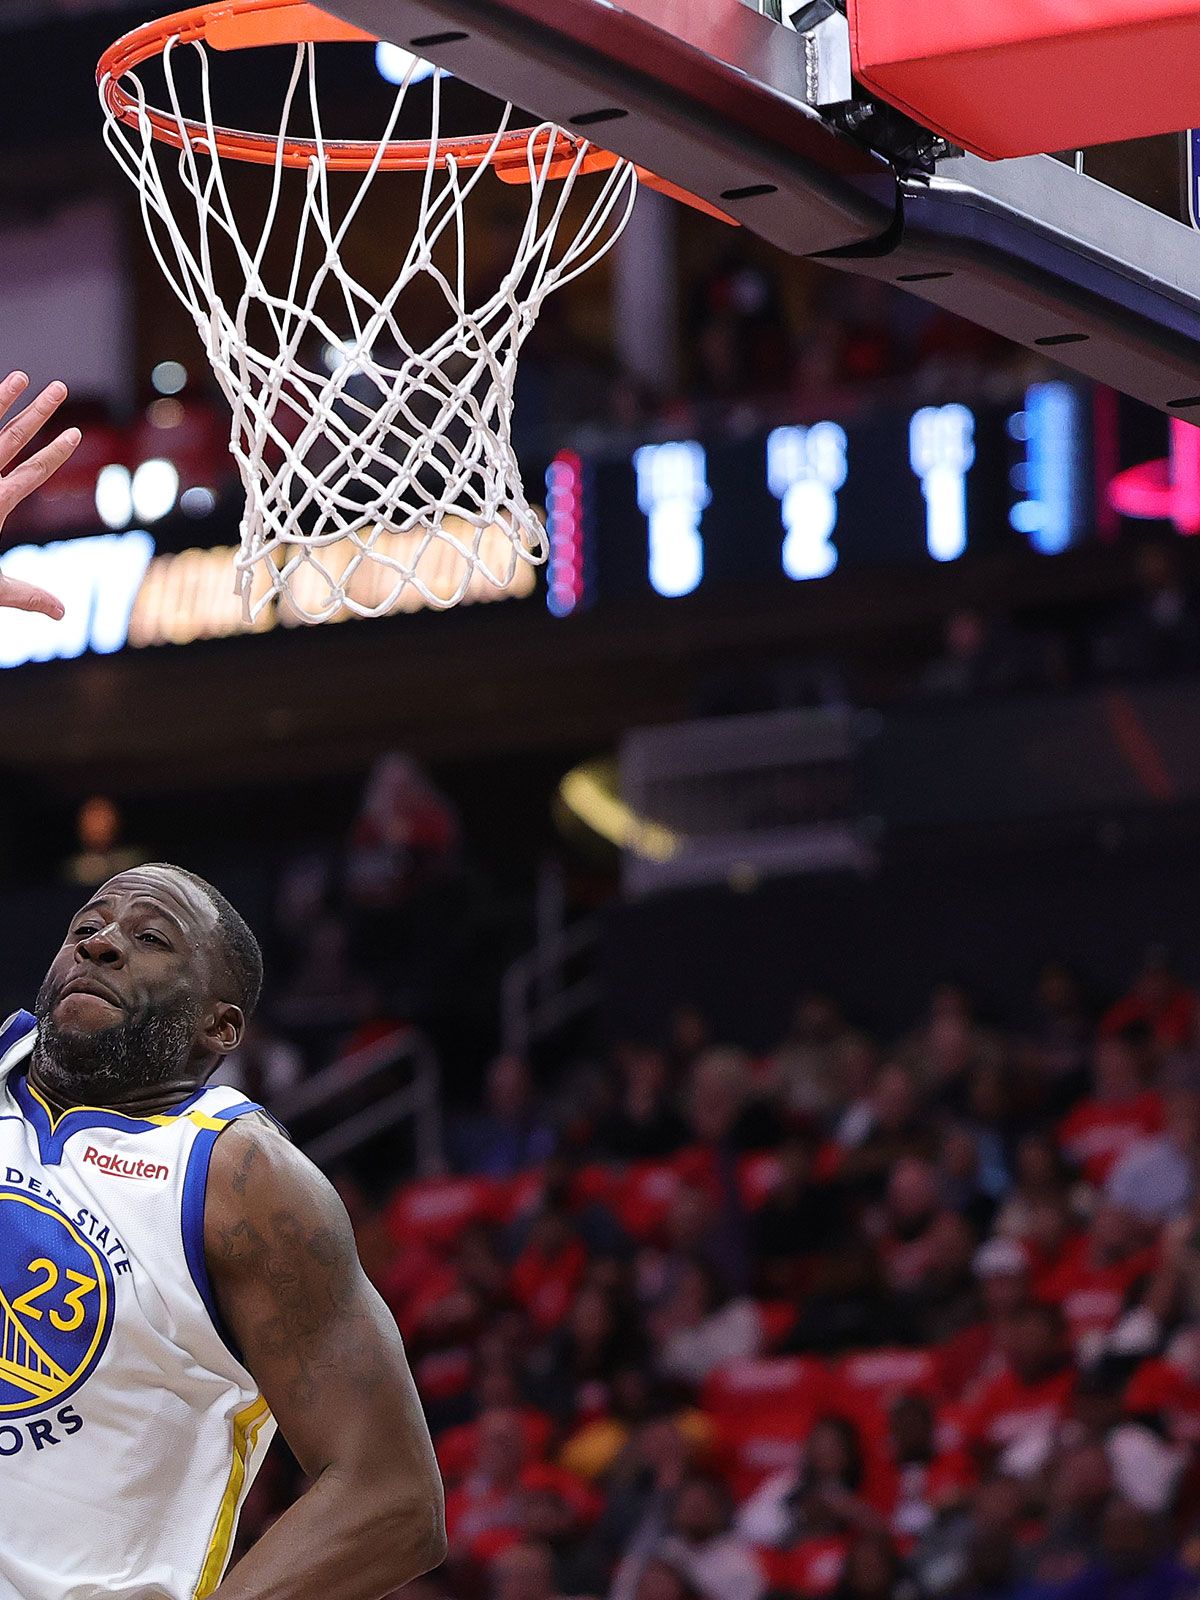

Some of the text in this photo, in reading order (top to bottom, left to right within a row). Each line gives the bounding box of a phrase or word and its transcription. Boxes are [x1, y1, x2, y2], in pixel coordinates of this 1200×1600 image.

[83, 1145, 169, 1182] Rakuten
[71, 1208, 133, 1276] STATE
[11, 1257, 98, 1332] 23
